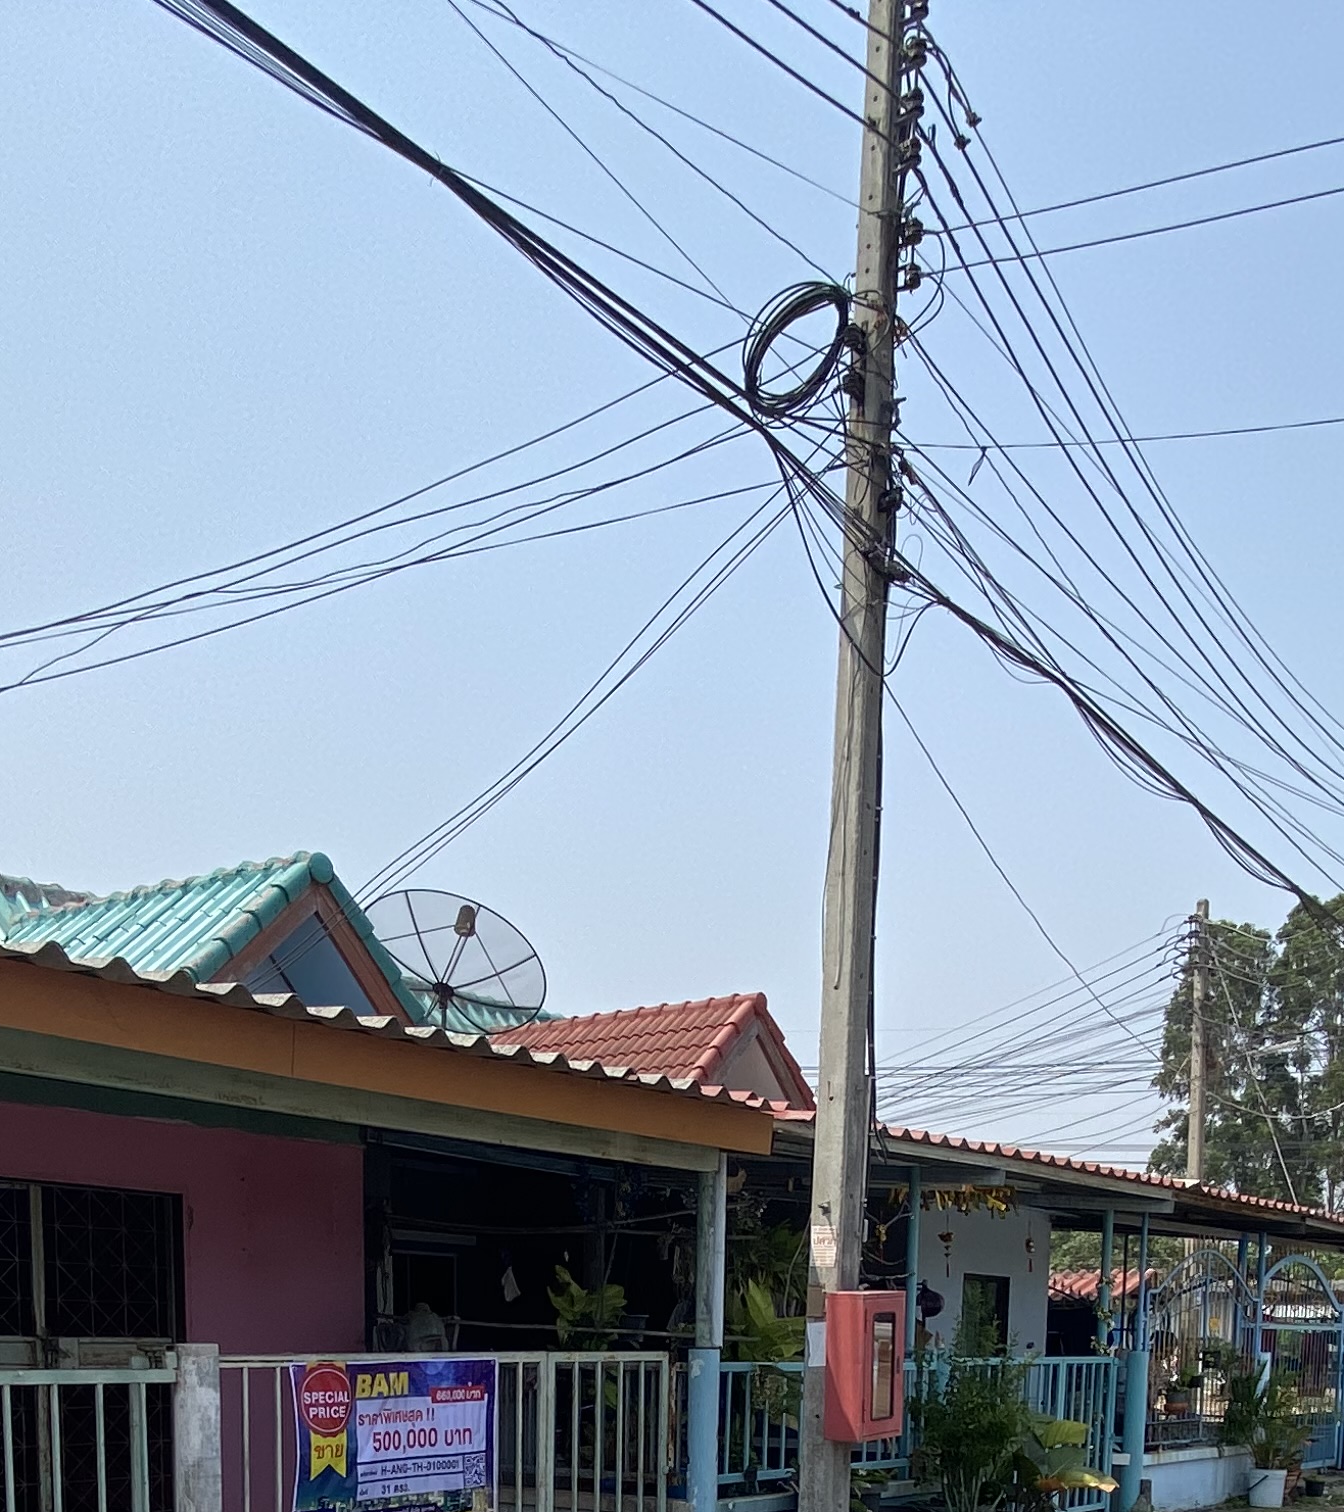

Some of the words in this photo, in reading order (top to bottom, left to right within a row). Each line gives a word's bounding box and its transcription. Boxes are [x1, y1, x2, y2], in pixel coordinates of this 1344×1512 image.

[356, 1371, 409, 1399] BAM
[303, 1390, 350, 1405] SPECIAL
[309, 1405, 346, 1419] PRICE
[373, 1427, 438, 1454] 500,000
[444, 1428, 473, 1447] บาท
[314, 1443, 344, 1460] ขาย
